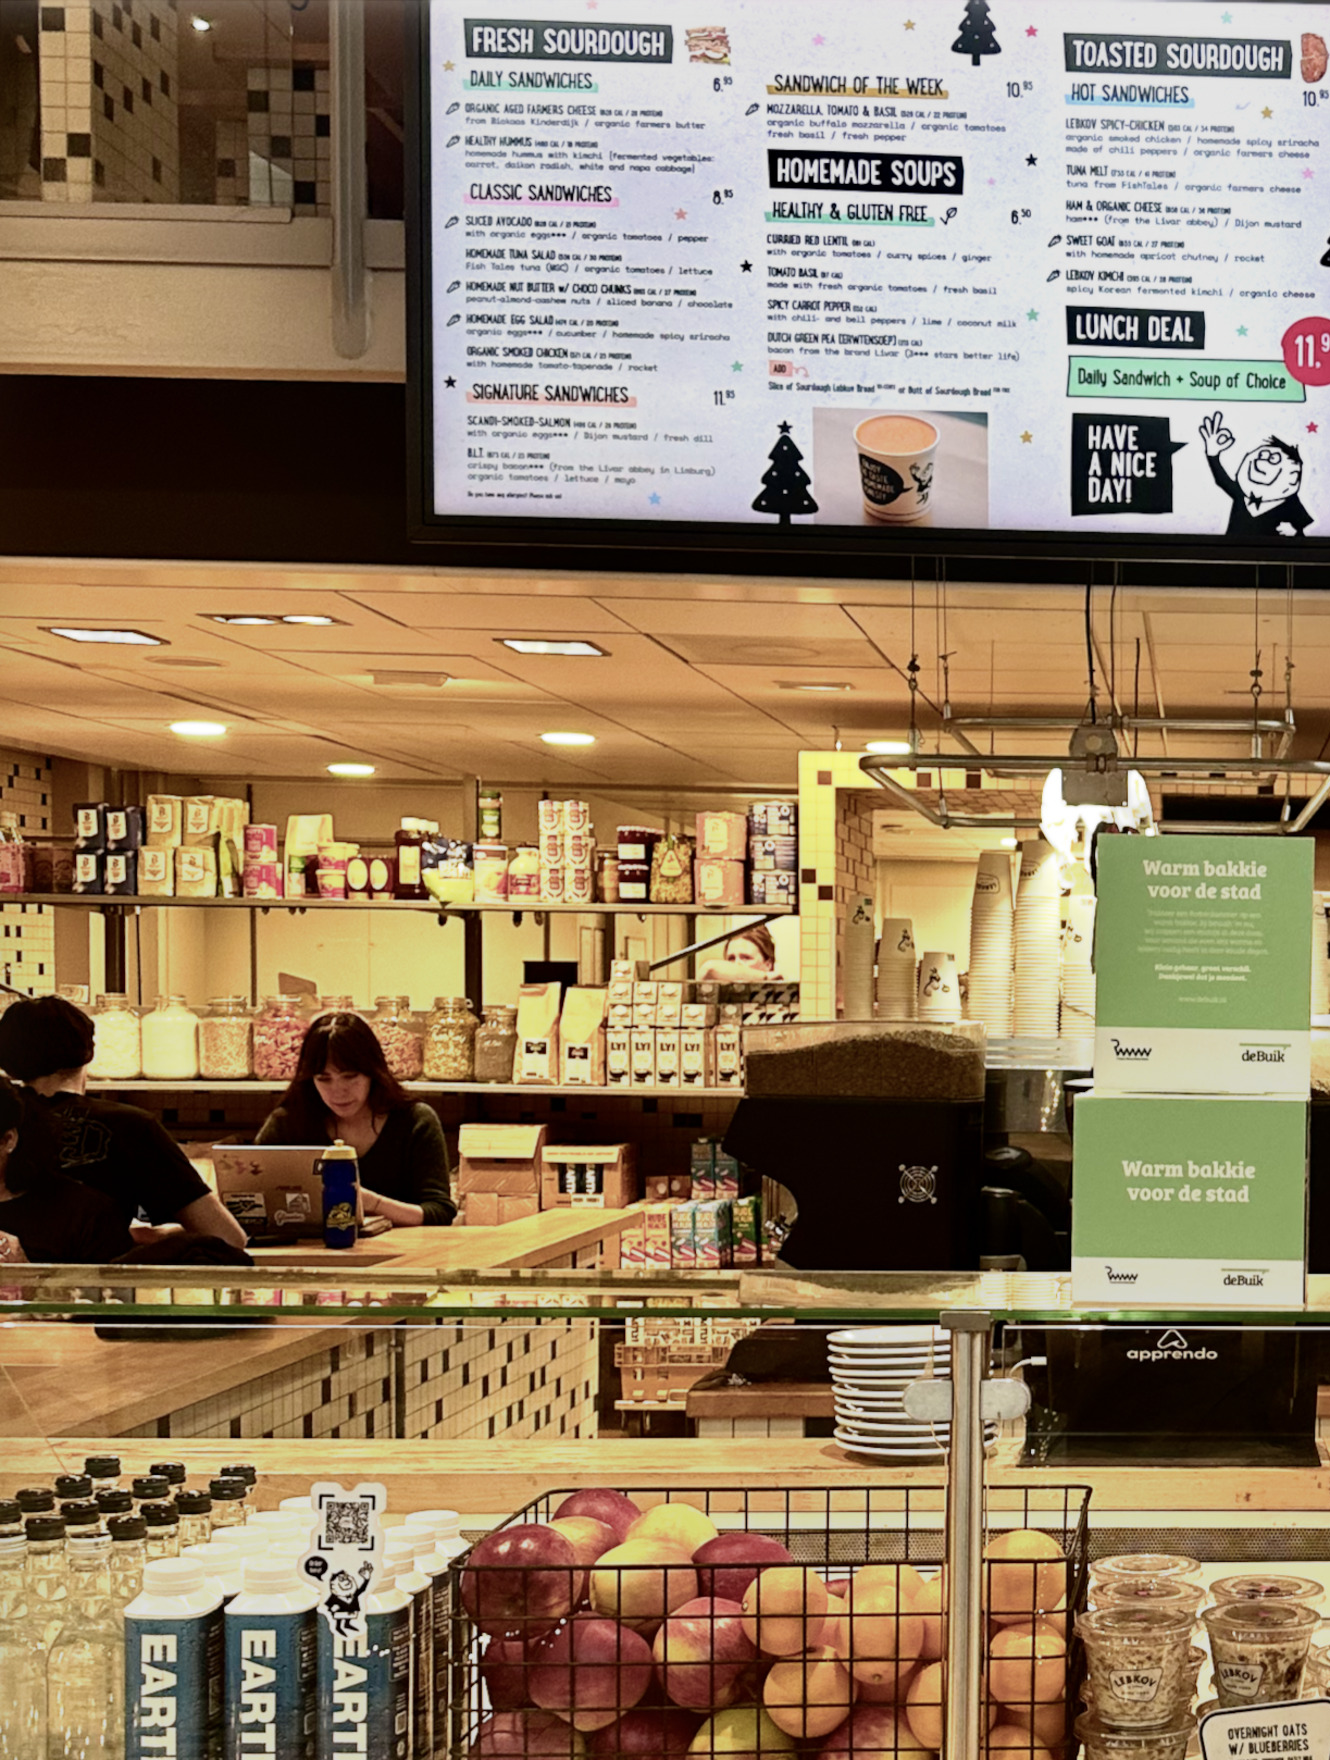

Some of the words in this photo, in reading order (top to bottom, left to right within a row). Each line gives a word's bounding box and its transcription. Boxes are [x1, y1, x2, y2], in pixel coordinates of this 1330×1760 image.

[472, 27, 534, 54] FRESH
[543, 29, 665, 57] SOURDOUGH
[1073, 40, 1157, 69] TOASTED
[1167, 43, 1283, 72] SOURDOUGH
[470, 71, 503, 88] DAILY
[509, 72, 593, 89] SANDWICHES
[774, 74, 846, 93] SANDWICH
[853, 77, 869, 94] OF
[876, 77, 900, 95] THE
[906, 78, 943, 96] WEEK
[1072, 84, 1097, 102] HOT
[1102, 85, 1189, 104] SANDWICHES
[567, 105, 596, 115] CHEESE
[1066, 119, 1096, 130] LEBKOV
[1101, 119, 1165, 131] SPICY-CHICKEN
[777, 158, 882, 185] HOMEMADE
[891, 160, 956, 187] SOUPS
[470, 184, 523, 201] CLASSIC
[529, 185, 612, 202] SANDWICHES
[773, 202, 823, 219] HEALTHY
[830, 204, 842, 220] &
[847, 205, 894, 221] GLUTEN
[899, 206, 927, 222] FREE
[1076, 313, 1138, 341] LUNCH
[1149, 316, 1194, 342] DEAL
[1078, 368, 1107, 386] Daily
[1113, 370, 1171, 386] Sandwich
[1190, 372, 1220, 390] Soup
[1226, 373, 1240, 389] of
[1246, 373, 1286, 389] Choice
[473, 384, 539, 401] SIGNATURE
[545, 386, 628, 403] SANDWICHES
[1089, 424, 1139, 450] HAVE
[1089, 452, 1102, 477] A
[1111, 452, 1156, 478] NICE
[1089, 478, 1132, 504] DAY!
[1143, 860, 1200, 876] Warm
[1203, 861, 1267, 877] bakkie
[1148, 885, 1191, 899] voor
[1195, 883, 1217, 899] de
[1221, 884, 1261, 900] stad
[1242, 1050, 1285, 1062] deBuik
[1122, 1161, 1183, 1177] Warm
[1188, 1161, 1255, 1178] bakkie
[1127, 1187, 1174, 1200] voor
[1179, 1185, 1201, 1201] de
[1206, 1186, 1249, 1202] stad
[1224, 1275, 1263, 1286] deBuik
[1127, 1348, 1217, 1362] apprendo
[1114, 1675, 1157, 1687] LEBKOV
[1220, 1665, 1259, 1683] LEBKOV
[141, 1634, 178, 1760] EART
[241, 1630, 276, 1760] EART
[332, 1632, 368, 1760] EART
[1228, 1725, 1278, 1739] OVERNIGHT
[1282, 1723, 1307, 1737] OATS
[1229, 1744, 1245, 1755] W/
[1249, 1740, 1309, 1753] BLUEBERRIES
